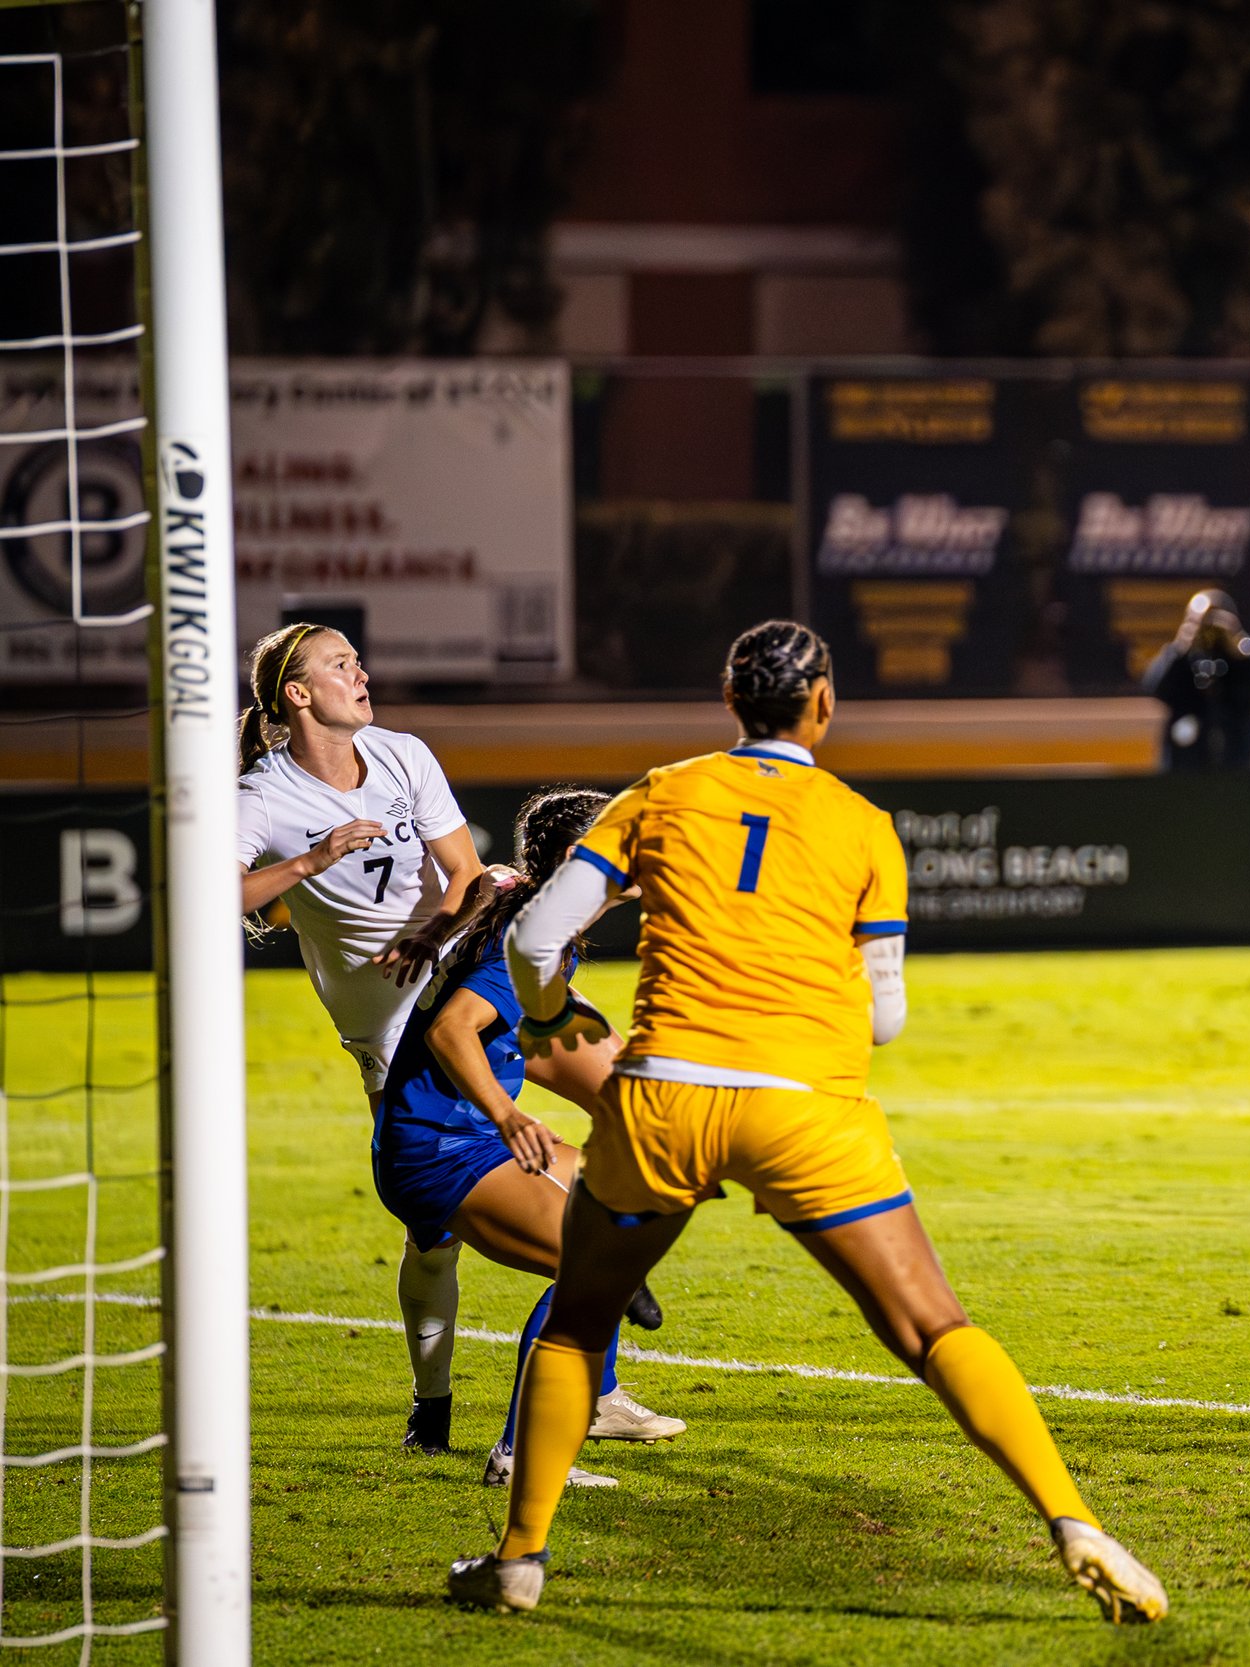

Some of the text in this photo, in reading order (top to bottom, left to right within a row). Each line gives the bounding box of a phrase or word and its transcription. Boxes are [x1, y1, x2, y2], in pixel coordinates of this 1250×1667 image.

[60, 828, 141, 937] B
[363, 855, 394, 904] 7
[735, 811, 771, 893] 1
[1003, 844, 1130, 888] BEACH
